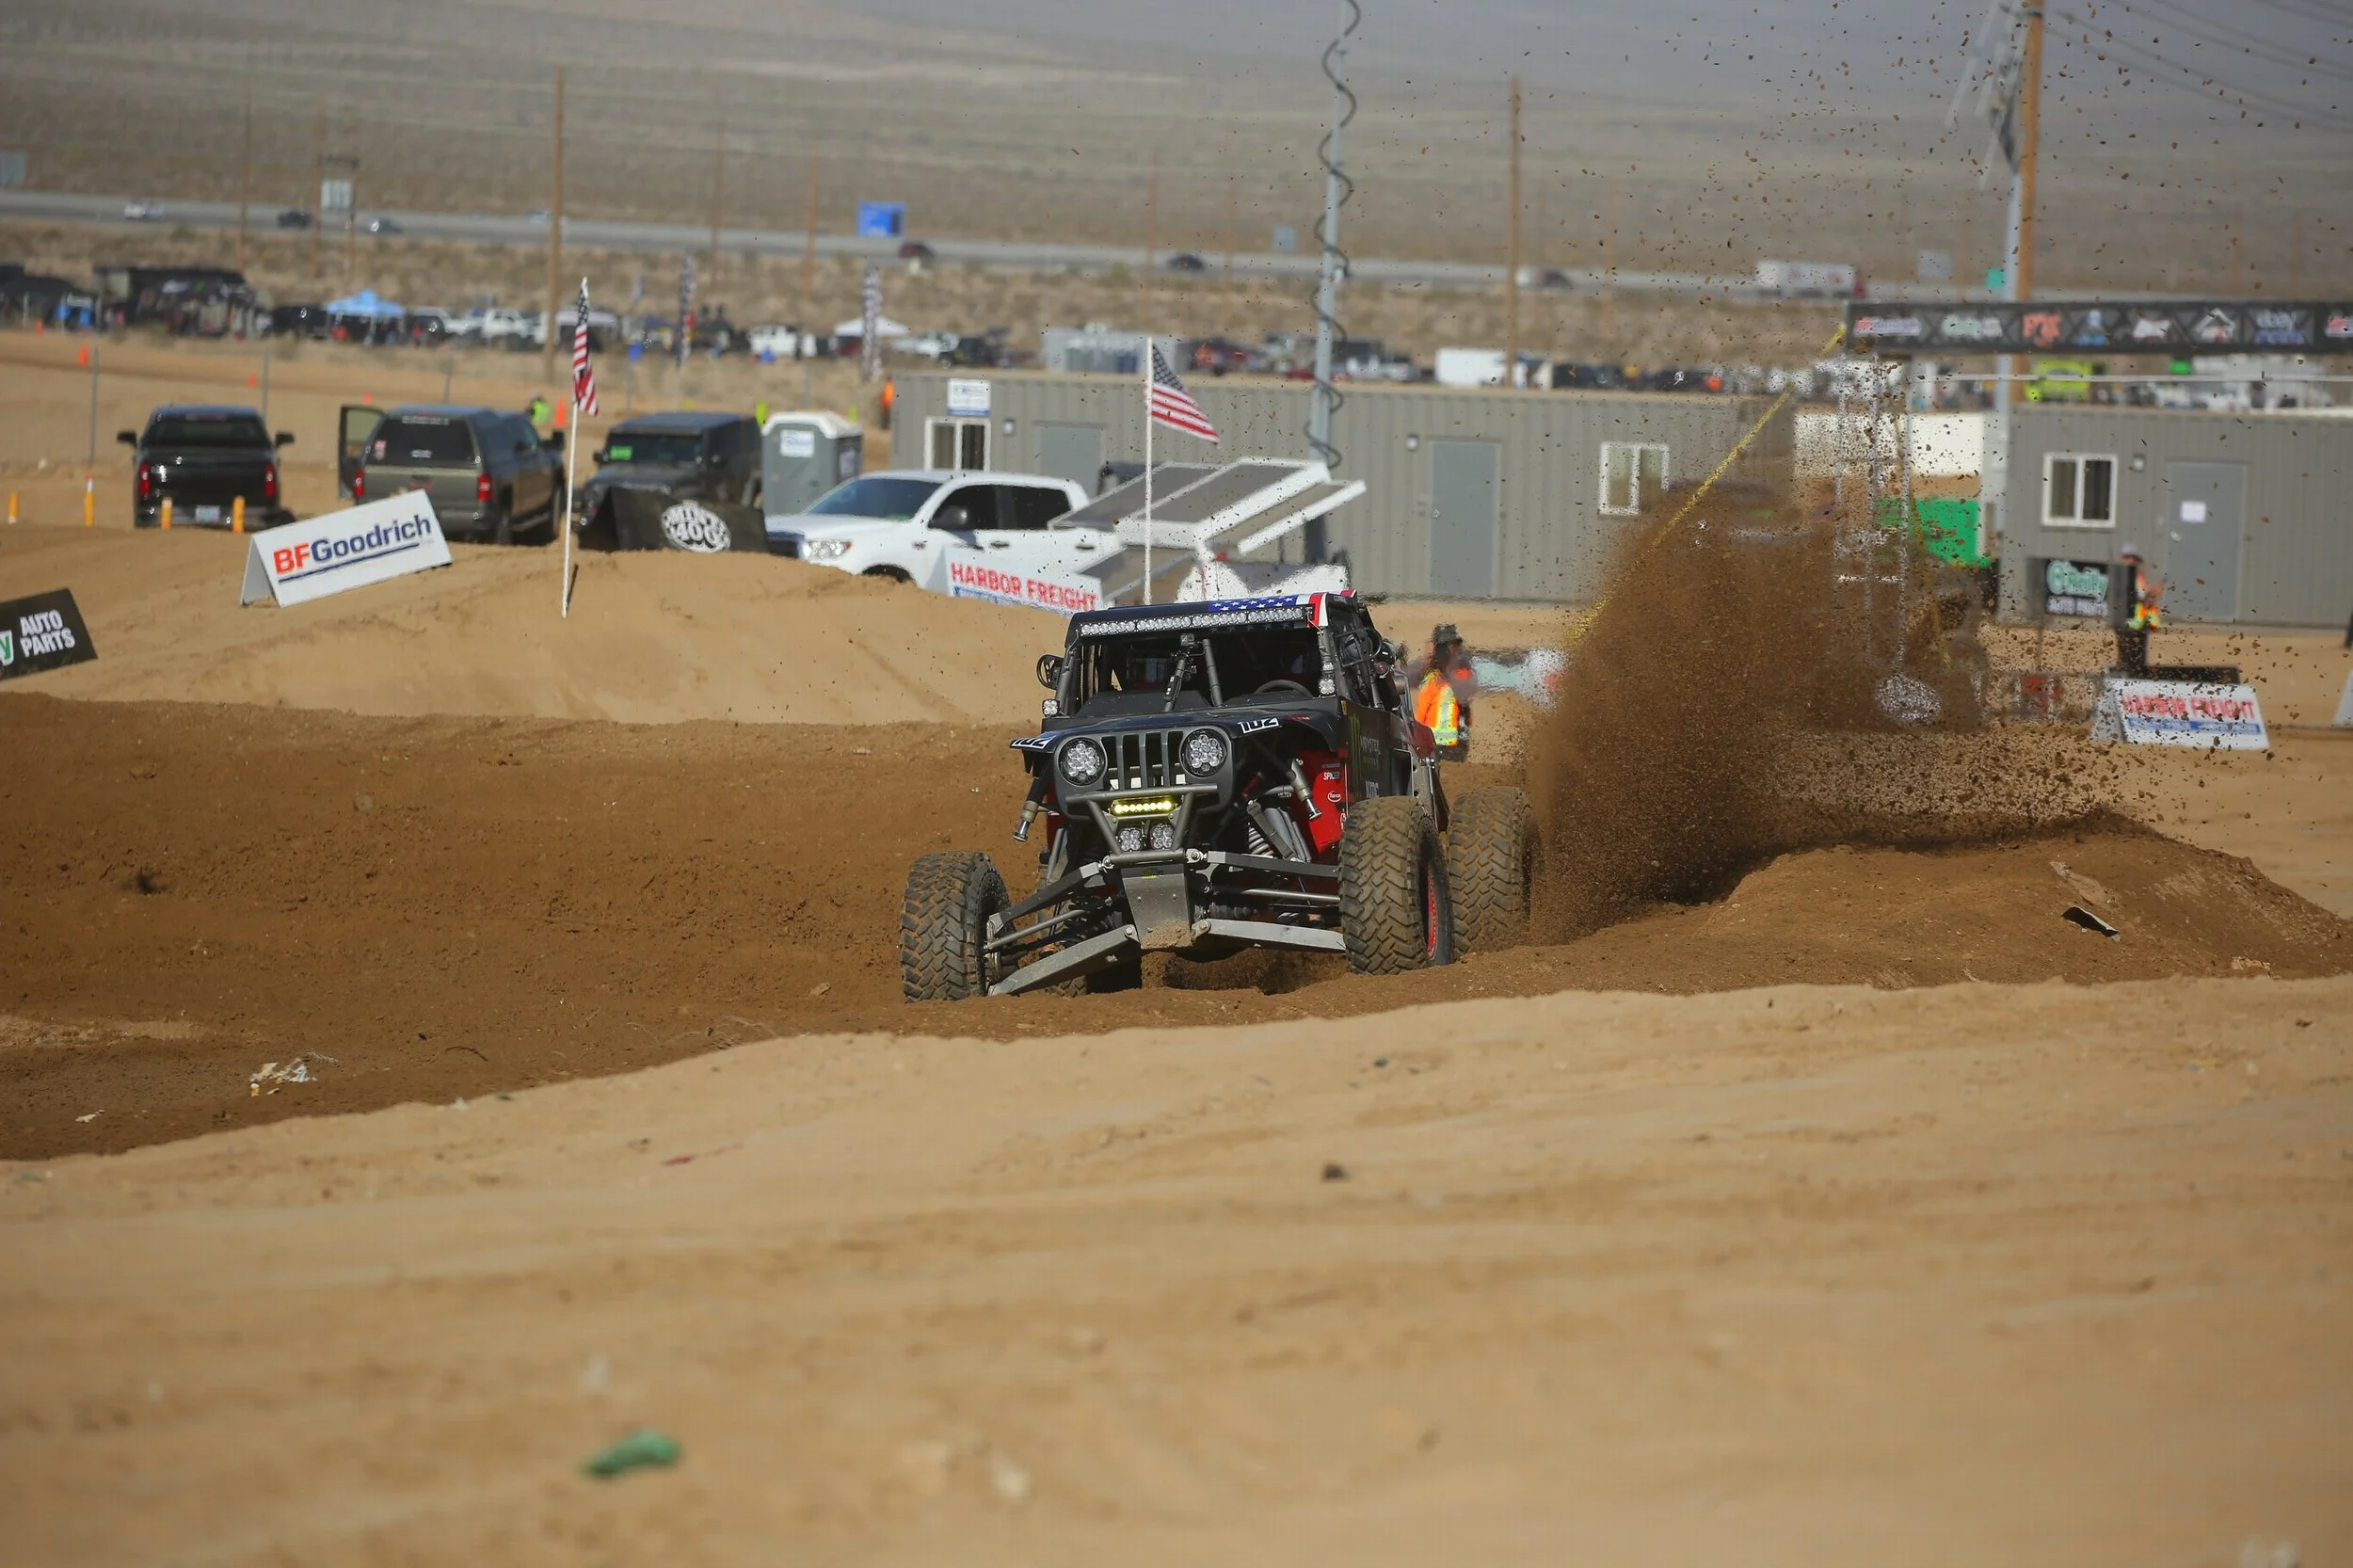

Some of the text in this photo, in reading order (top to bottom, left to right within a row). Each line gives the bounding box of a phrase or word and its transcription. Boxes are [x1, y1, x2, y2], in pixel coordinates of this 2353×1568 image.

[273, 514, 432, 575] BFGoodrich
[951, 562, 1022, 595] HARBOR
[1026, 578, 1096, 613] FREIGHT
[20, 609, 63, 637] AUTO
[20, 627, 75, 658] PARTS
[1238, 717, 1279, 733] 102
[1323, 771, 1341, 780] SPICER
